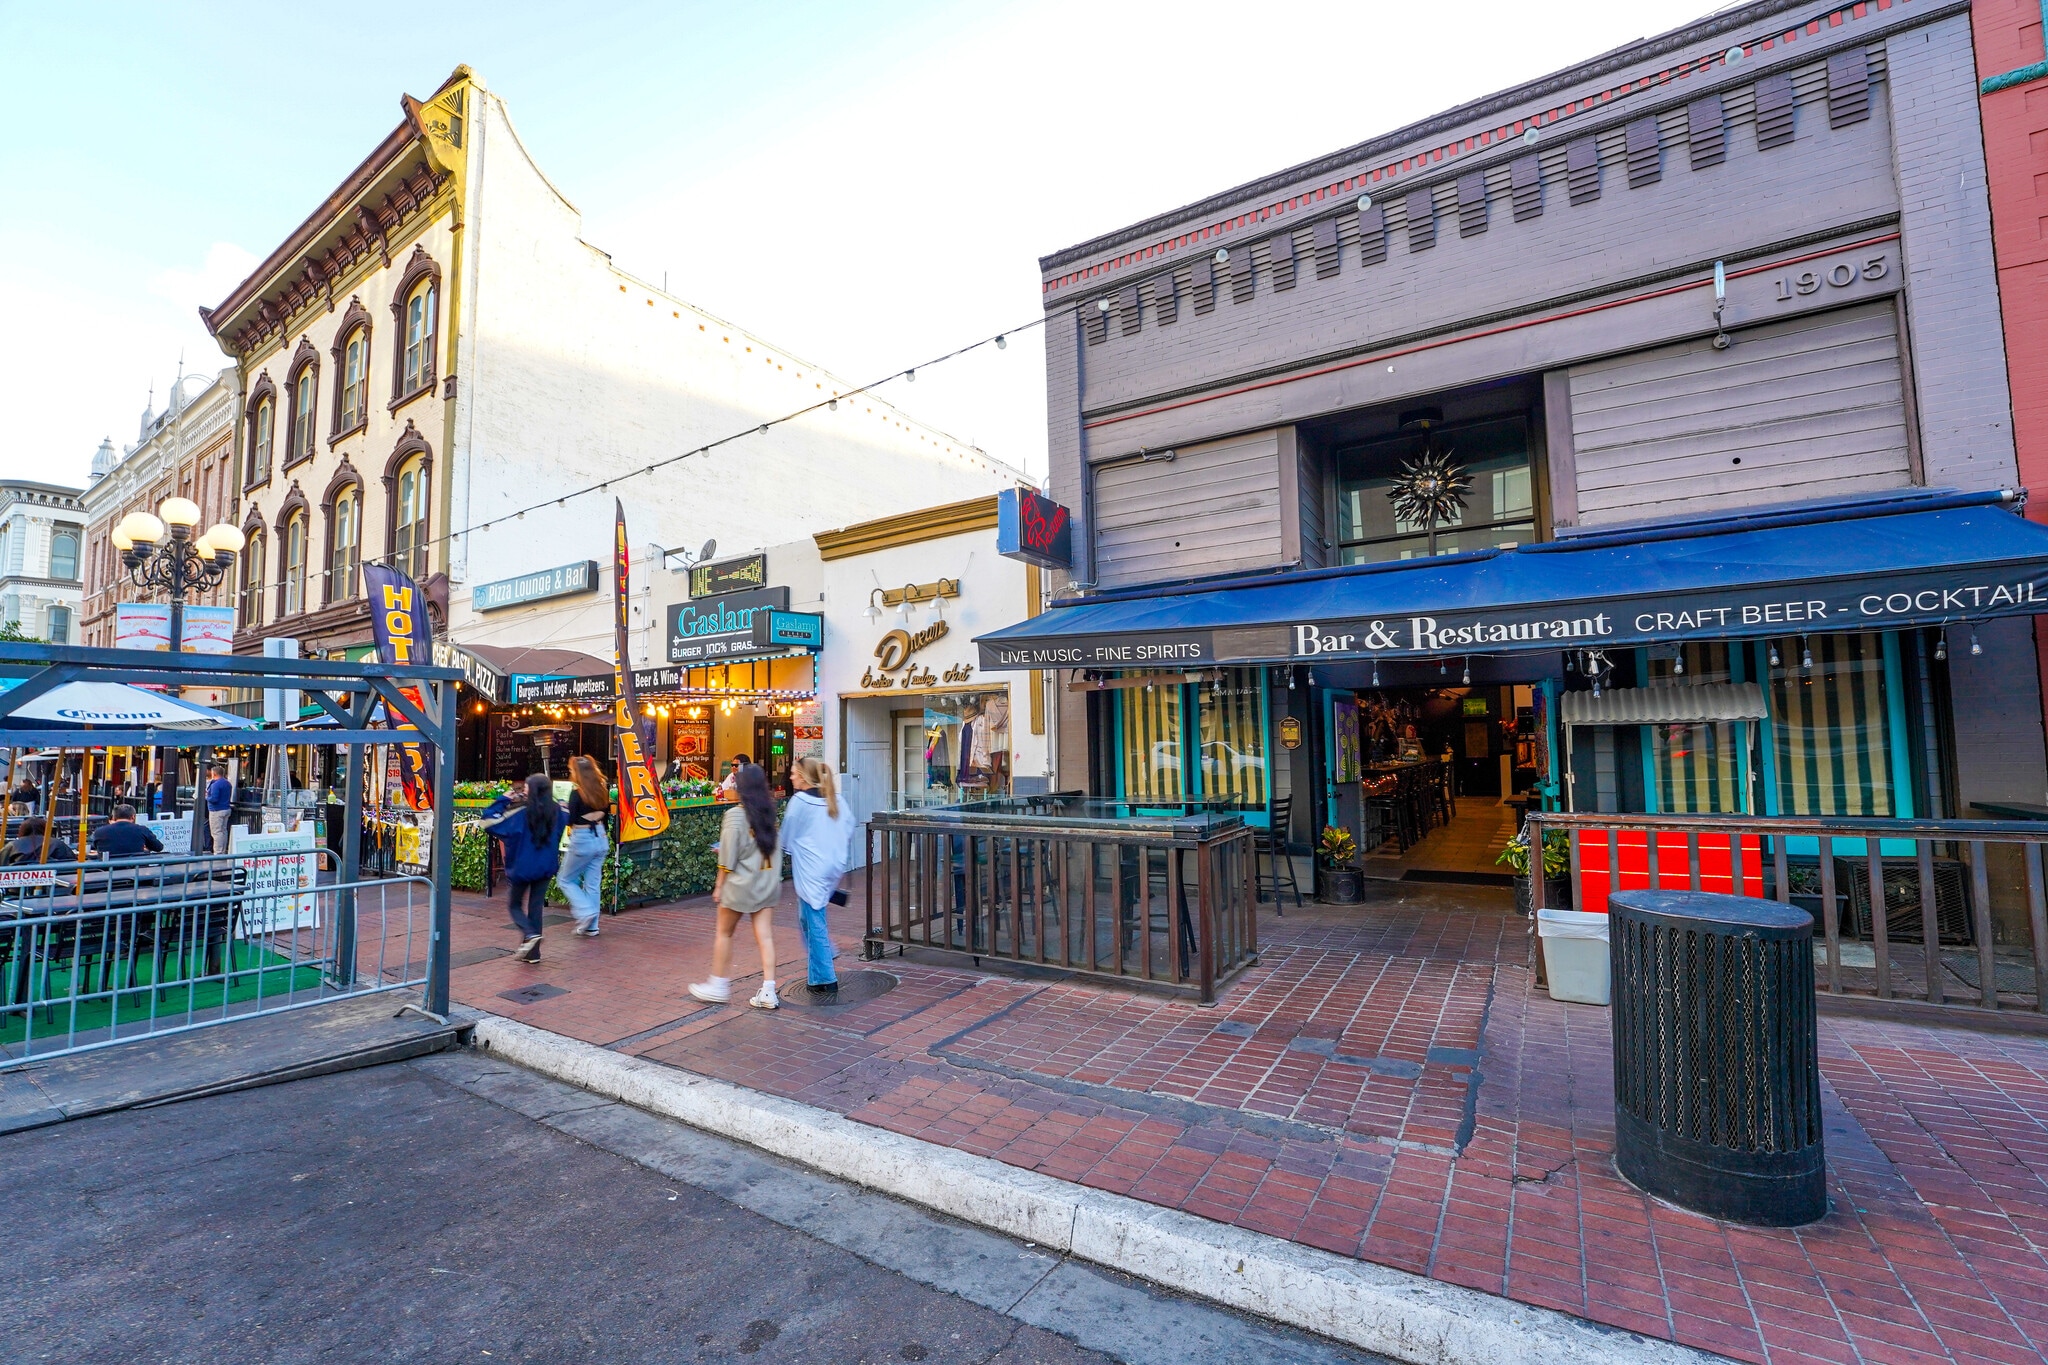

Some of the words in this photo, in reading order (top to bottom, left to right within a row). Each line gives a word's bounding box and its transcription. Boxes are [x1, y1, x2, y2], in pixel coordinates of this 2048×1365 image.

[1775, 254, 1888, 301] 1905
[489, 583, 512, 603] Pizza
[514, 574, 551, 598] Lounge
[554, 570, 562, 589] &
[565, 567, 585, 587] Bar
[383, 584, 413, 661] HOT
[776, 616, 817, 633] Gaslamp
[1635, 607, 1732, 632] CRAFT
[1742, 600, 1827, 625] BEER
[1859, 582, 2048, 616] COCKTAIL
[671, 645, 702, 659] BURGER
[705, 641, 728, 655] 100%
[873, 619, 950, 671] Dream
[1293, 624, 1354, 656] Bar
[1364, 620, 1400, 650] &
[1407, 612, 1613, 651] Restaurant
[1000, 650, 1030, 664] LIVE
[1034, 648, 1083, 663] MUSIC
[1096, 647, 1132, 662] FINE
[1136, 643, 1201, 660] SPIRITS
[475, 662, 497, 701] PIZZA
[518, 684, 540, 701] Burgers
[543, 681, 554, 696] Hot
[554, 680, 568, 697] dogs
[572, 679, 606, 698] Appetizers
[635, 673, 652, 688] Beer
[653, 671, 659, 684] &
[660, 668, 679, 686] Wine
[57, 708, 163, 721] Corona
[771, 746, 784, 754] TM
